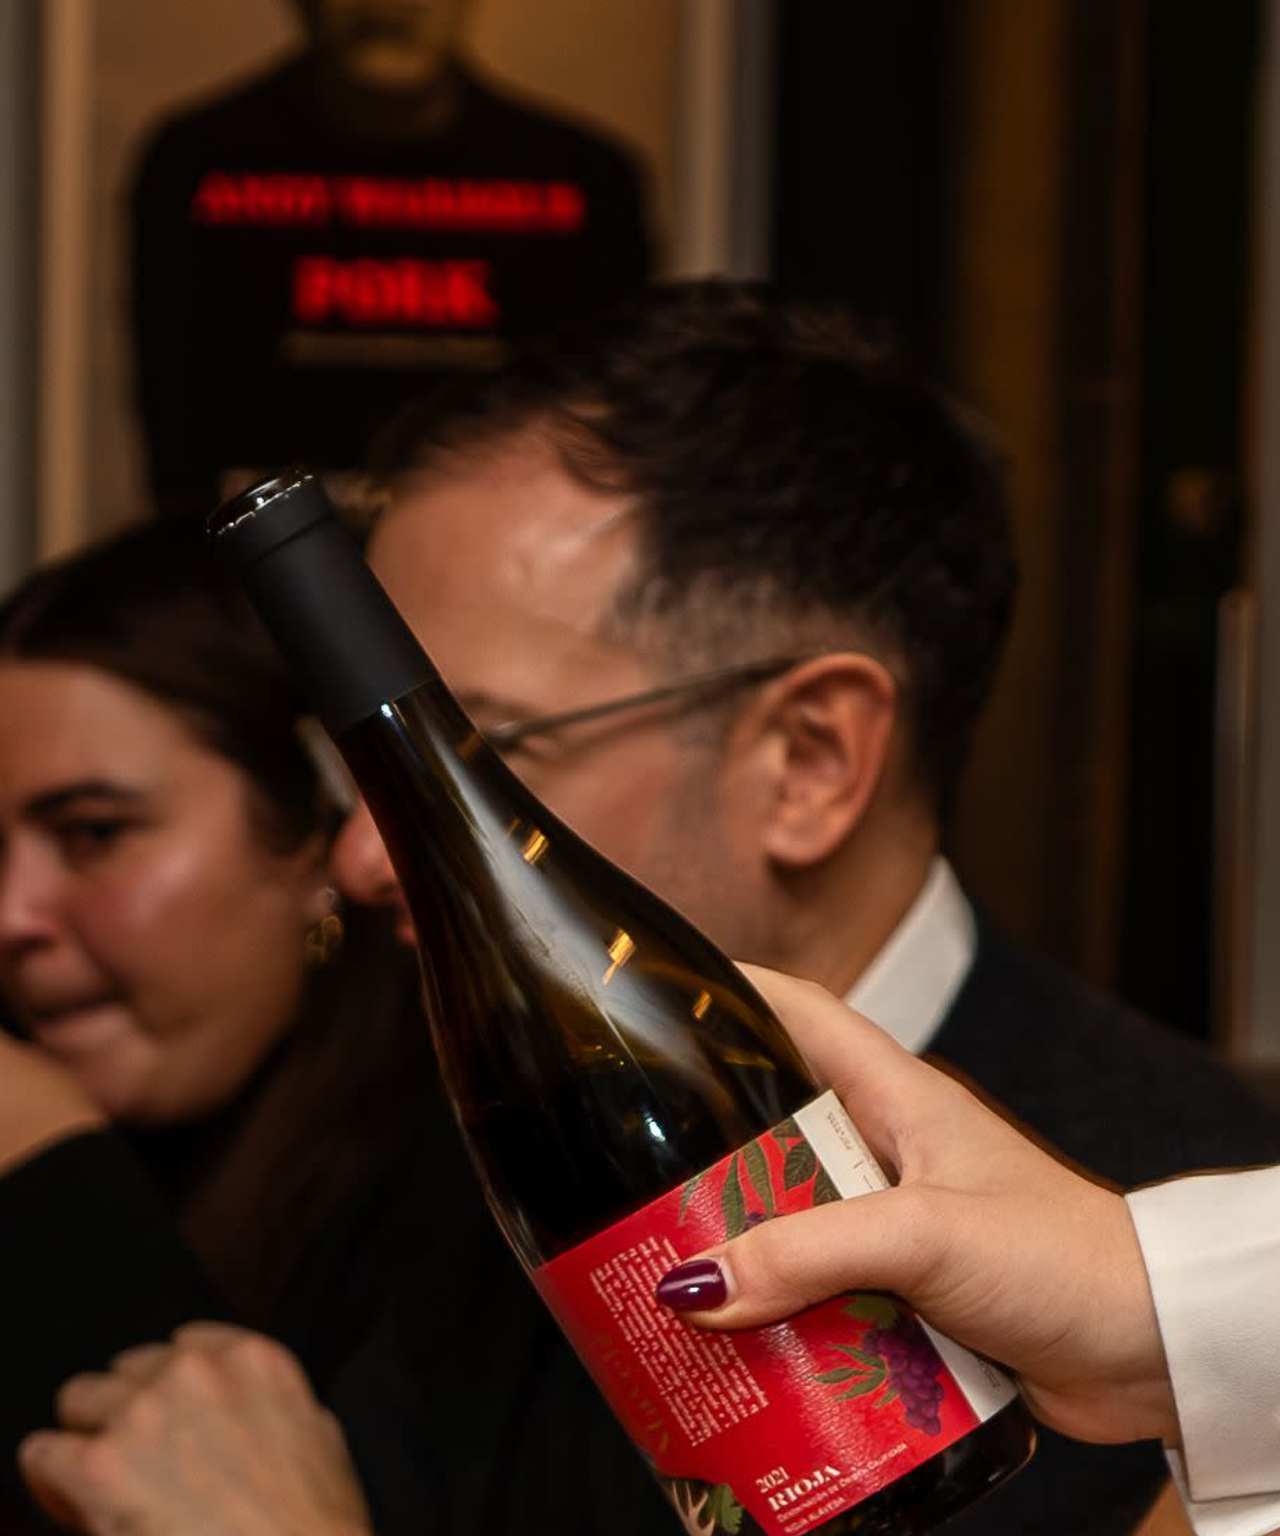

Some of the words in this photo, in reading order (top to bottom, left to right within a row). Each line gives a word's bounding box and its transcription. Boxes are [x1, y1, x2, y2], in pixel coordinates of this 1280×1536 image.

[295, 254, 500, 327] PORK
[755, 1466, 790, 1494] 2021
[768, 1465, 841, 1511] RIOJA
